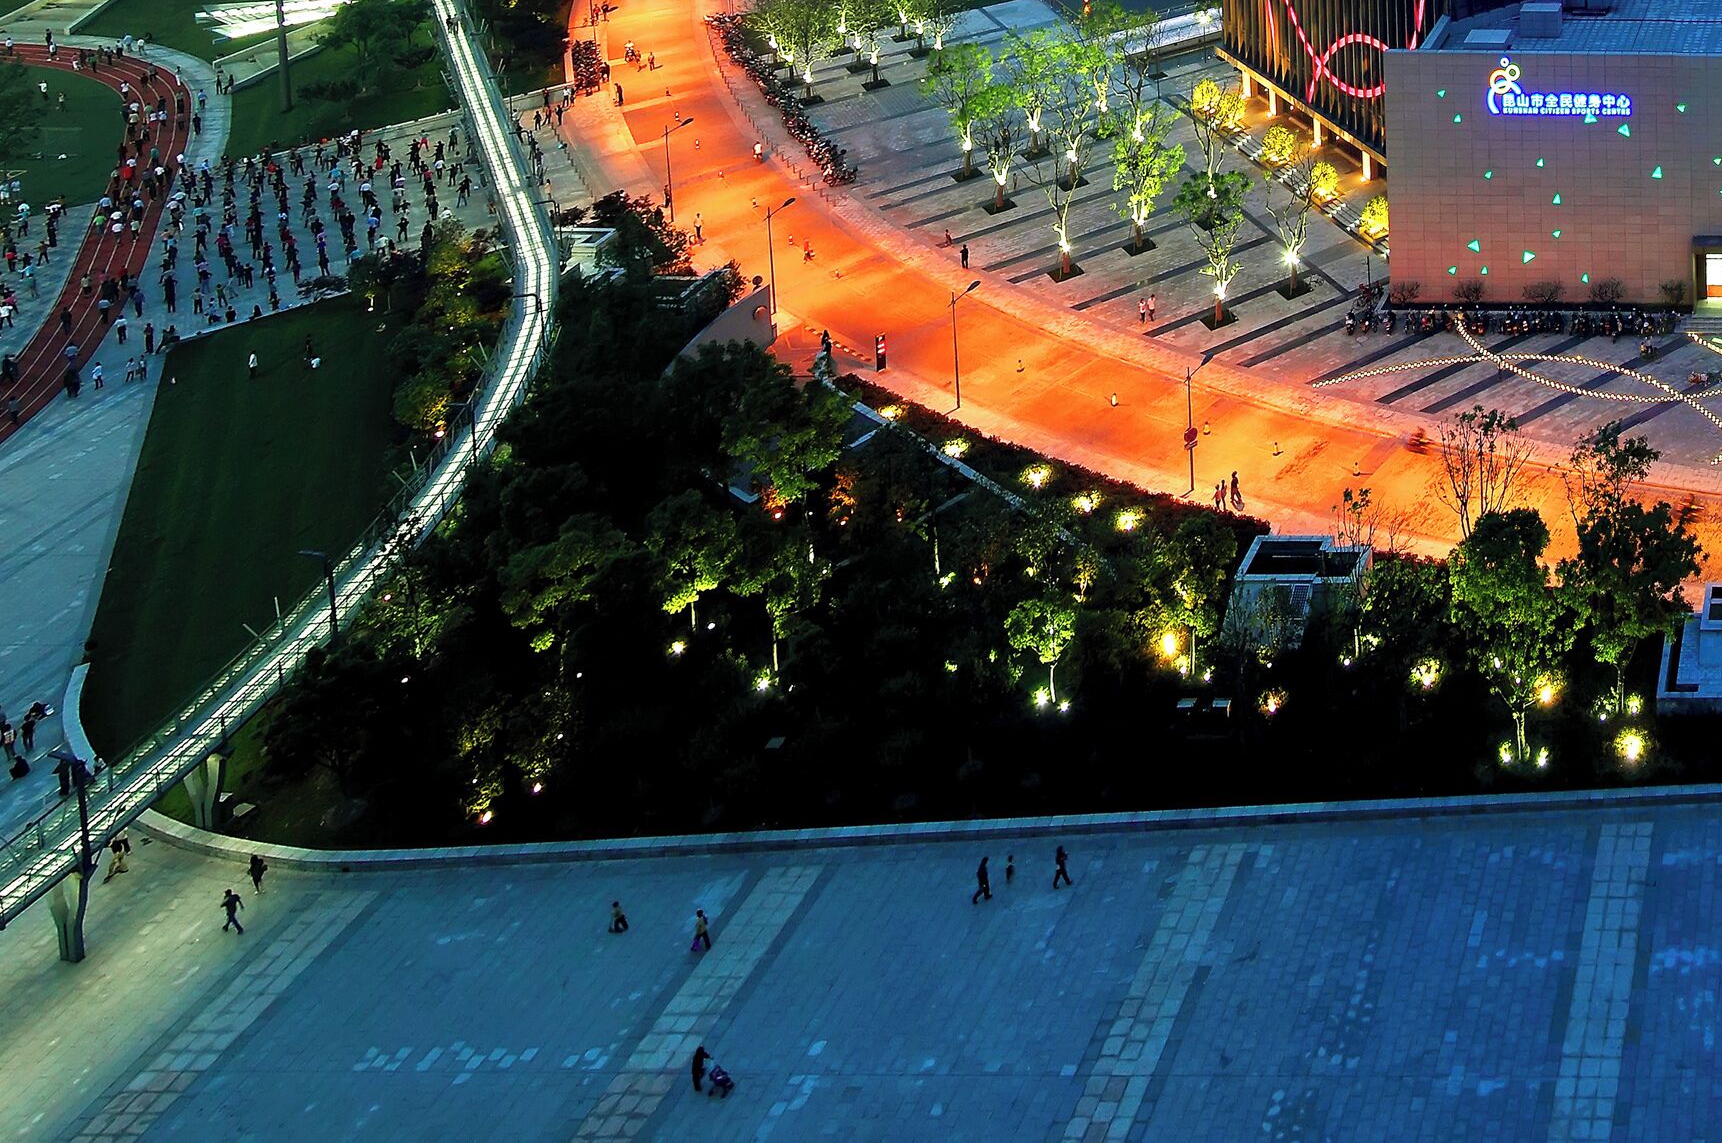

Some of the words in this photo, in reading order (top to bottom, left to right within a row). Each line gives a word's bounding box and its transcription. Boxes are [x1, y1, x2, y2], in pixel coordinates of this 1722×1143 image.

[1502, 93, 1631, 108] 昆山市全民健身中心
[1502, 107, 1539, 115] KUNSHAN
[1540, 107, 1570, 115] CITIZEN
[1571, 107, 1600, 115] SPORTS
[1601, 107, 1631, 115] CENTRE
